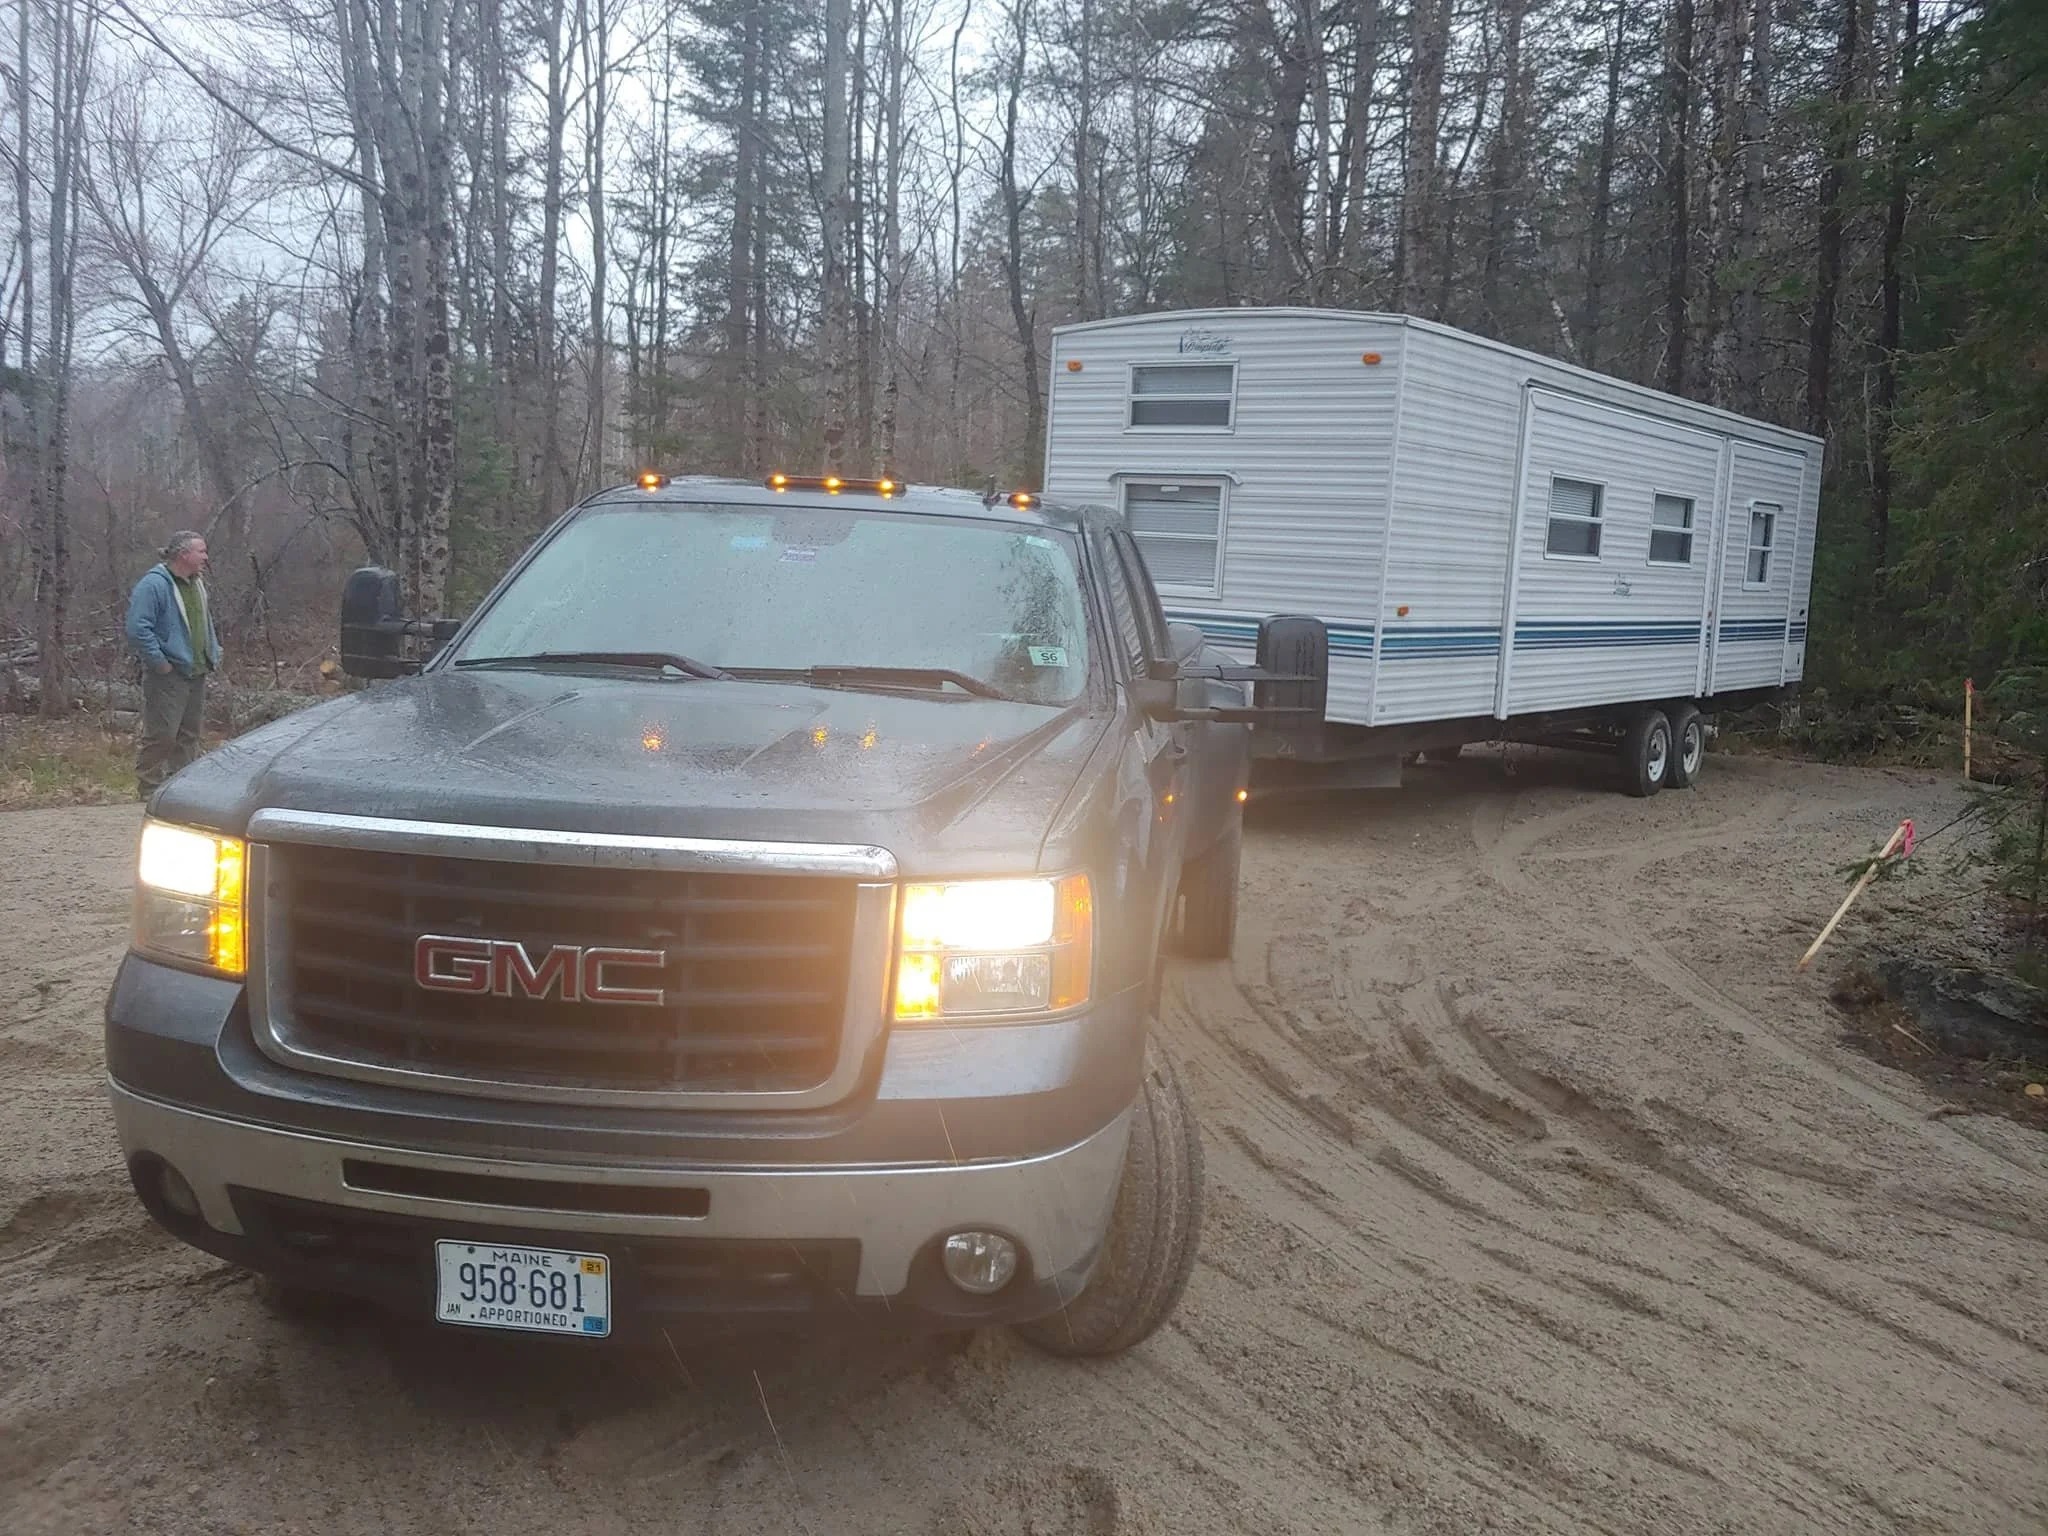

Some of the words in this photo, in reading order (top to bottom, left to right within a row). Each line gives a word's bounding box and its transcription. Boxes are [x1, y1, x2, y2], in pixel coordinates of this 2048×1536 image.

[415, 934, 666, 1006] GMC
[493, 1251, 553, 1267] MAINE
[446, 1303, 461, 1314] JAN
[479, 1306, 567, 1327] APPORTIONED
